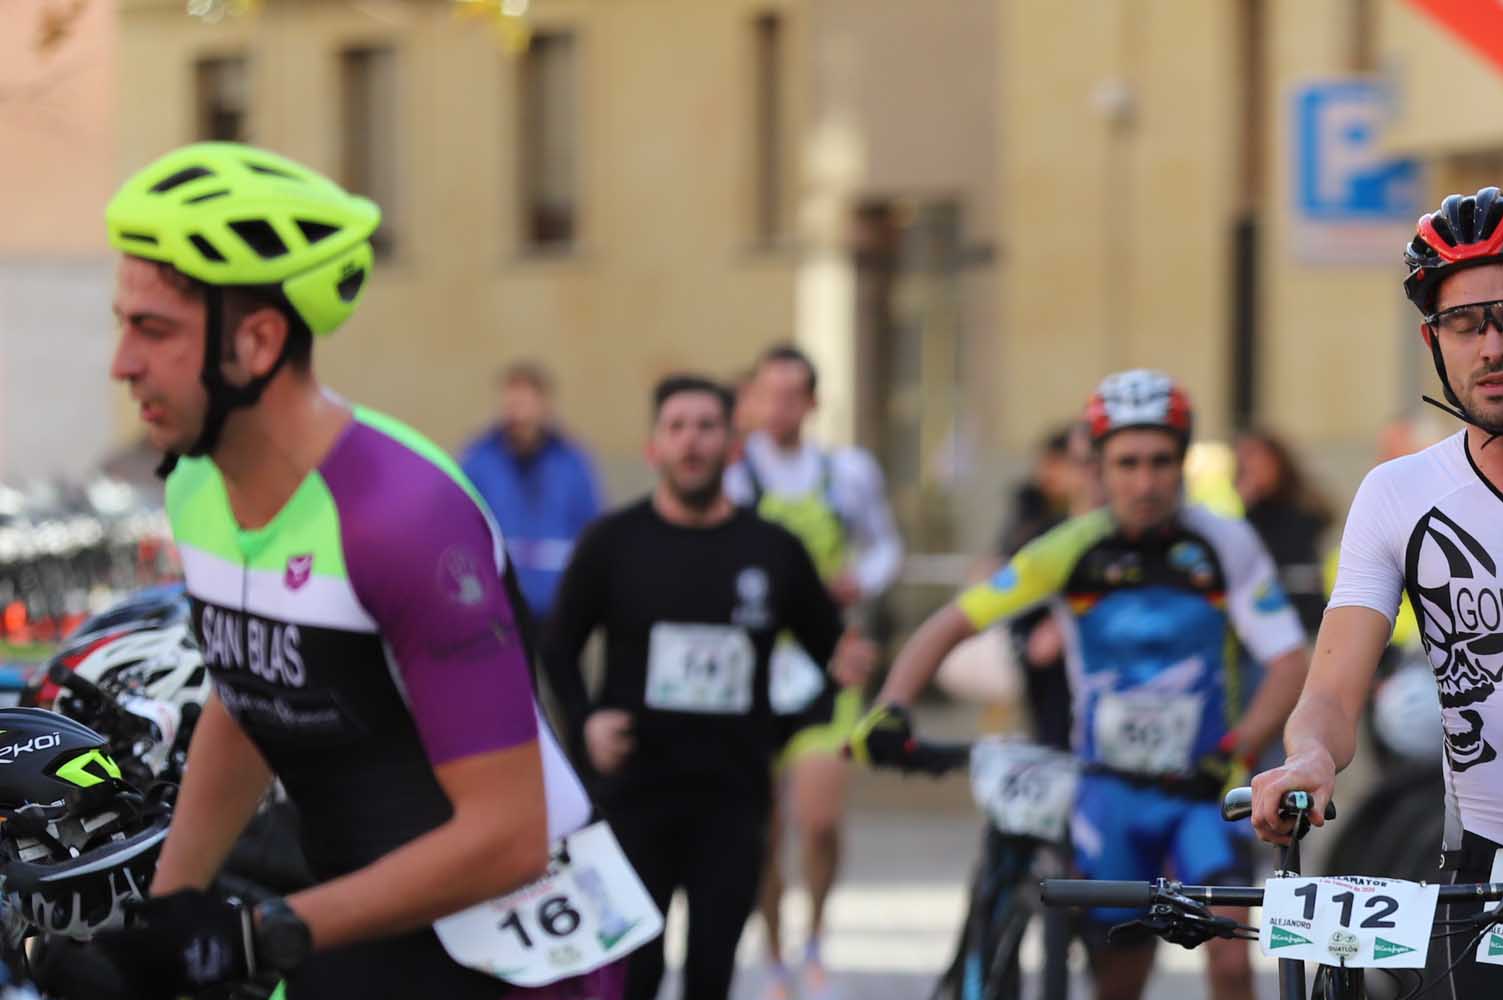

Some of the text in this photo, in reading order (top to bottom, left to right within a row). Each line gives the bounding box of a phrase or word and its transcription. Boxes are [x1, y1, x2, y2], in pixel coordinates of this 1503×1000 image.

[203, 605, 306, 688] SAN BLAS
[498, 896, 582, 948] 16
[1269, 917, 1312, 930] ALEJANDRO
[1294, 882, 1400, 930] 112
